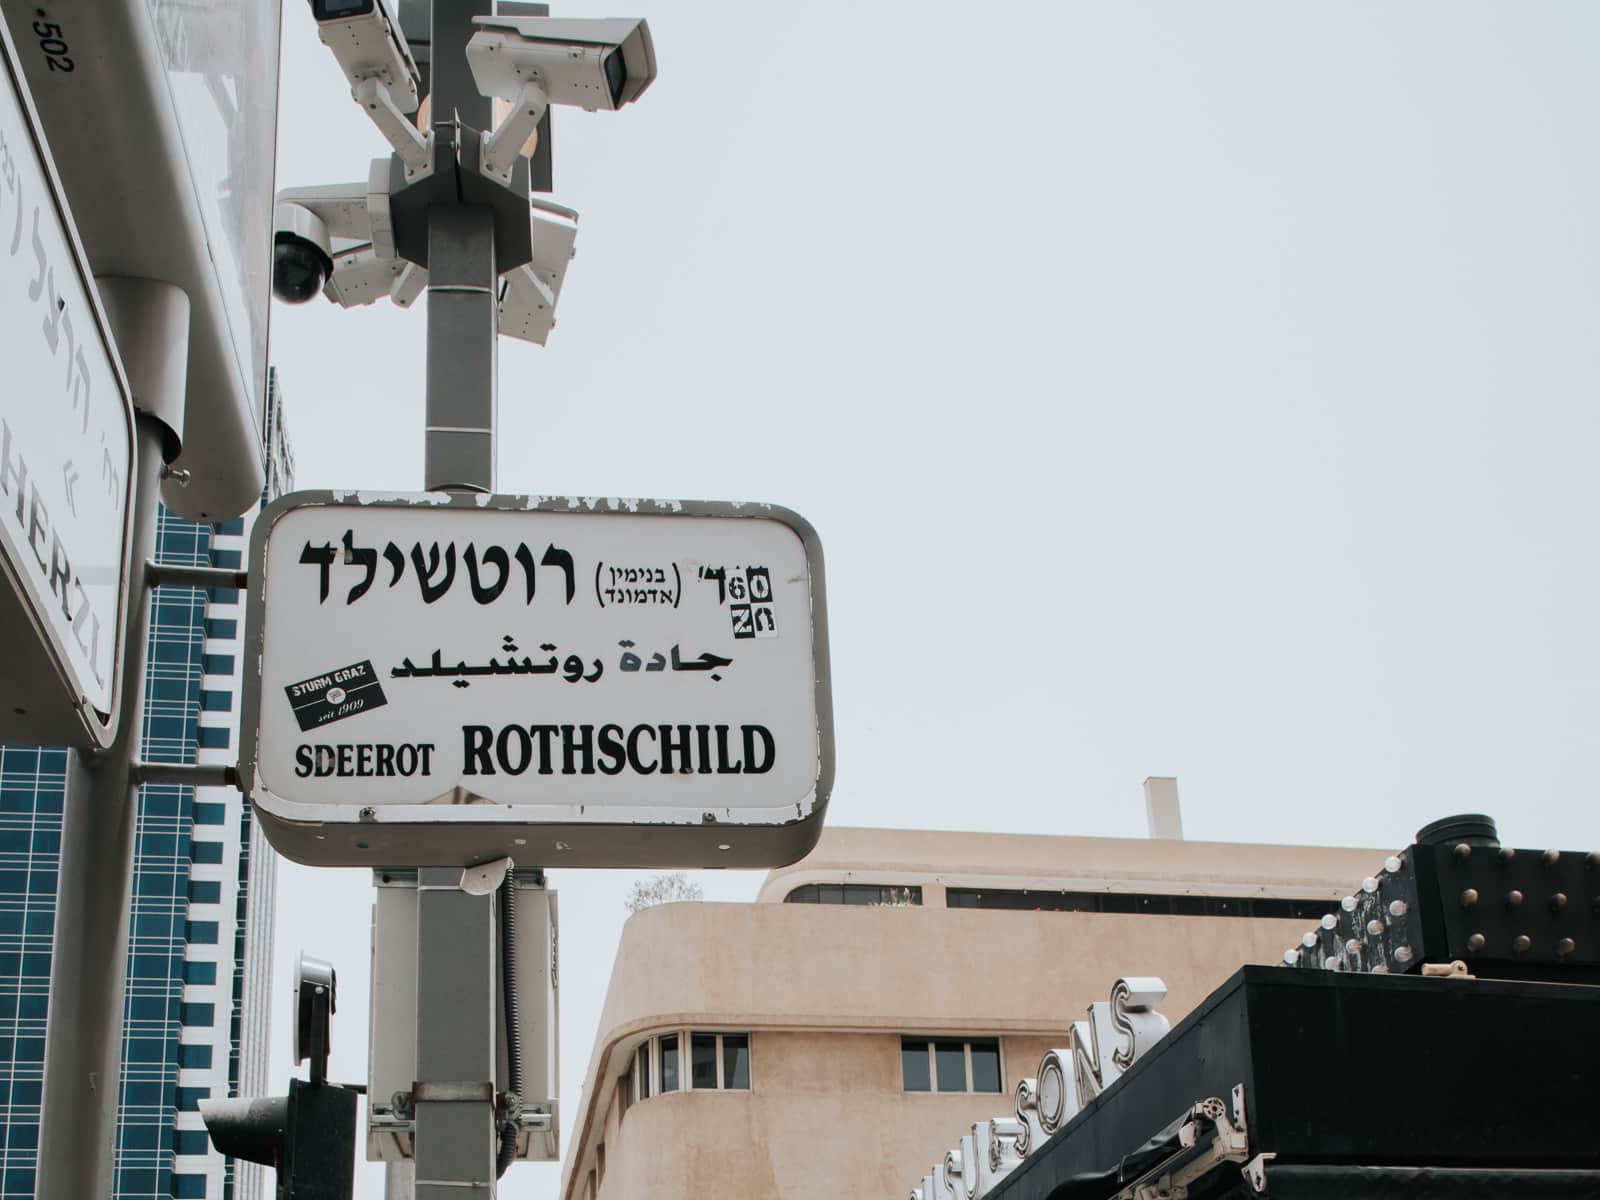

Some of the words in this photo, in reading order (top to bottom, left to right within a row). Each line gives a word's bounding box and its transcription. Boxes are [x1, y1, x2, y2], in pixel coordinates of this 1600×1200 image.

[0, 417, 105, 691] HERZL
[299, 529, 576, 606] רוטשילד
[292, 676, 333, 697] STURM
[334, 665, 367, 684] GRAZ
[390, 635, 604, 688] روتشيلد
[618, 639, 734, 682] جادة
[318, 711, 335, 723] seit
[337, 698, 364, 716] 1909
[294, 742, 436, 778] SDEEROT
[461, 723, 777, 777] ROTHSCHILD
